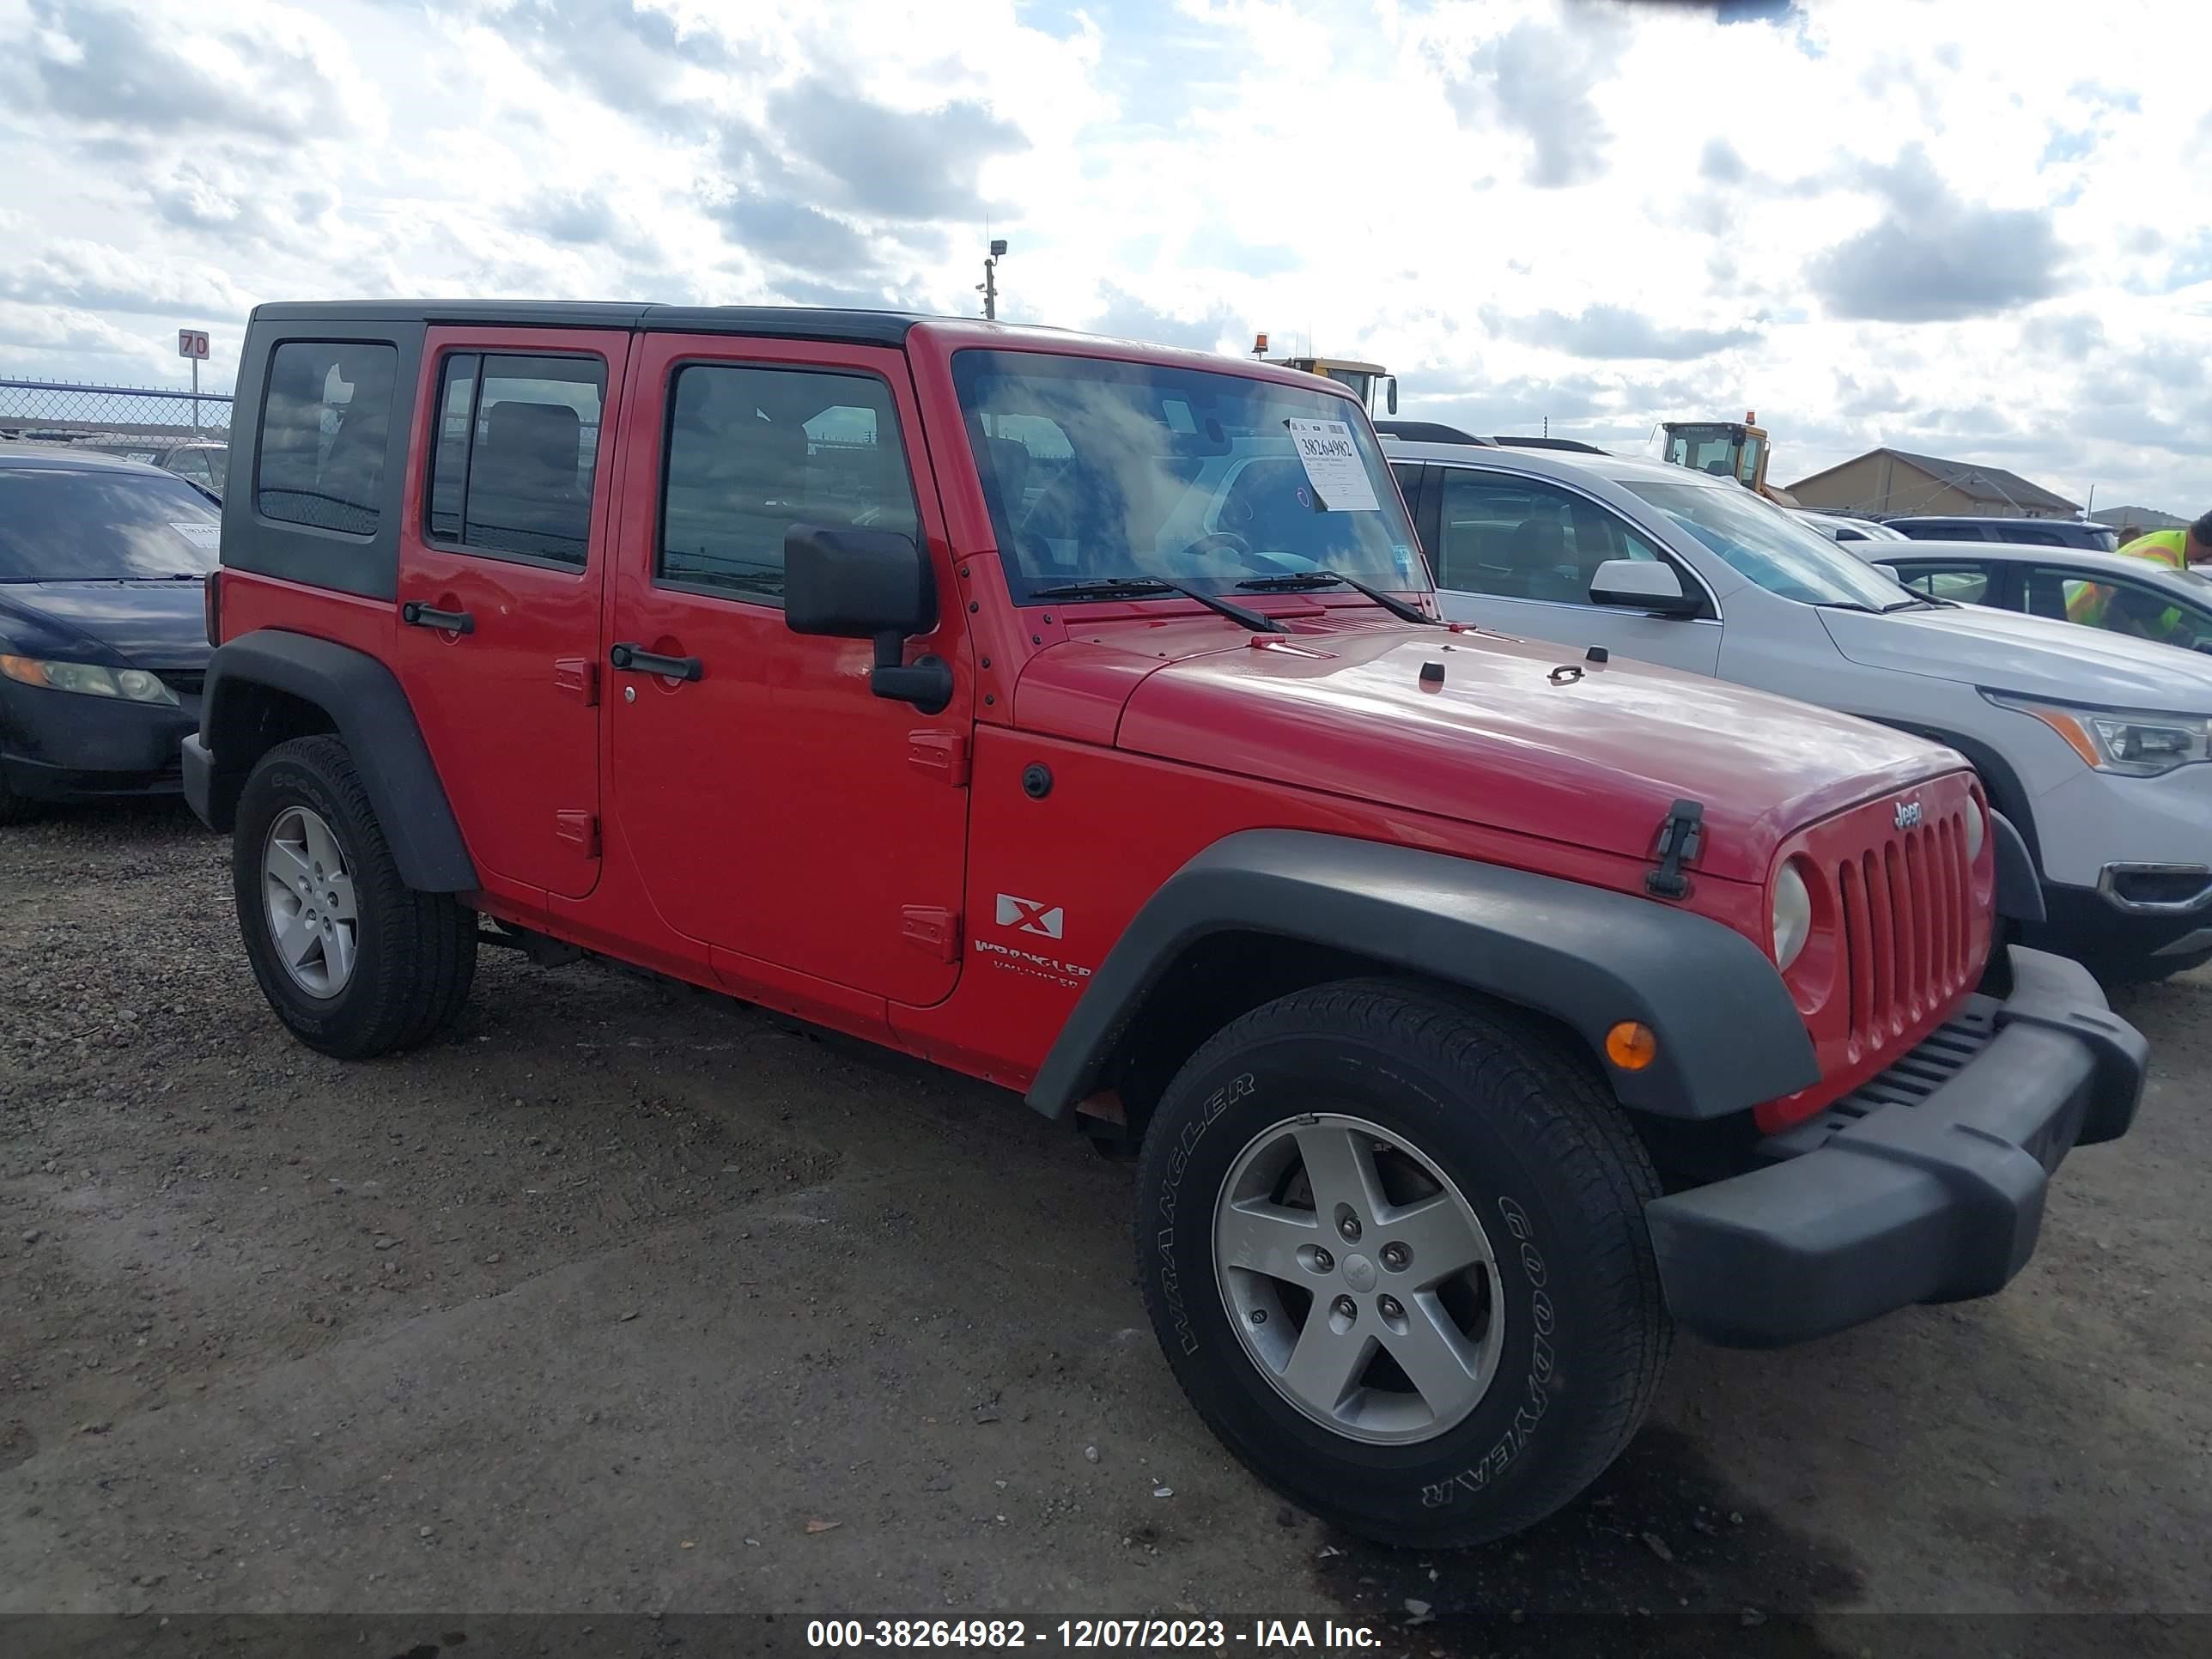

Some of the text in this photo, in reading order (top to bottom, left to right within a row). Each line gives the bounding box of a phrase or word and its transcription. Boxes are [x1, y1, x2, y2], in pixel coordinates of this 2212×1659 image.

[1301, 438, 1352, 458] 38264982
[1894, 801, 1923, 830] Jeep
[975, 939, 1092, 977] WRANGLER
[1158, 1073, 1255, 1357] WRANGLER
[1421, 1195, 1556, 1508] GOODYEAR
